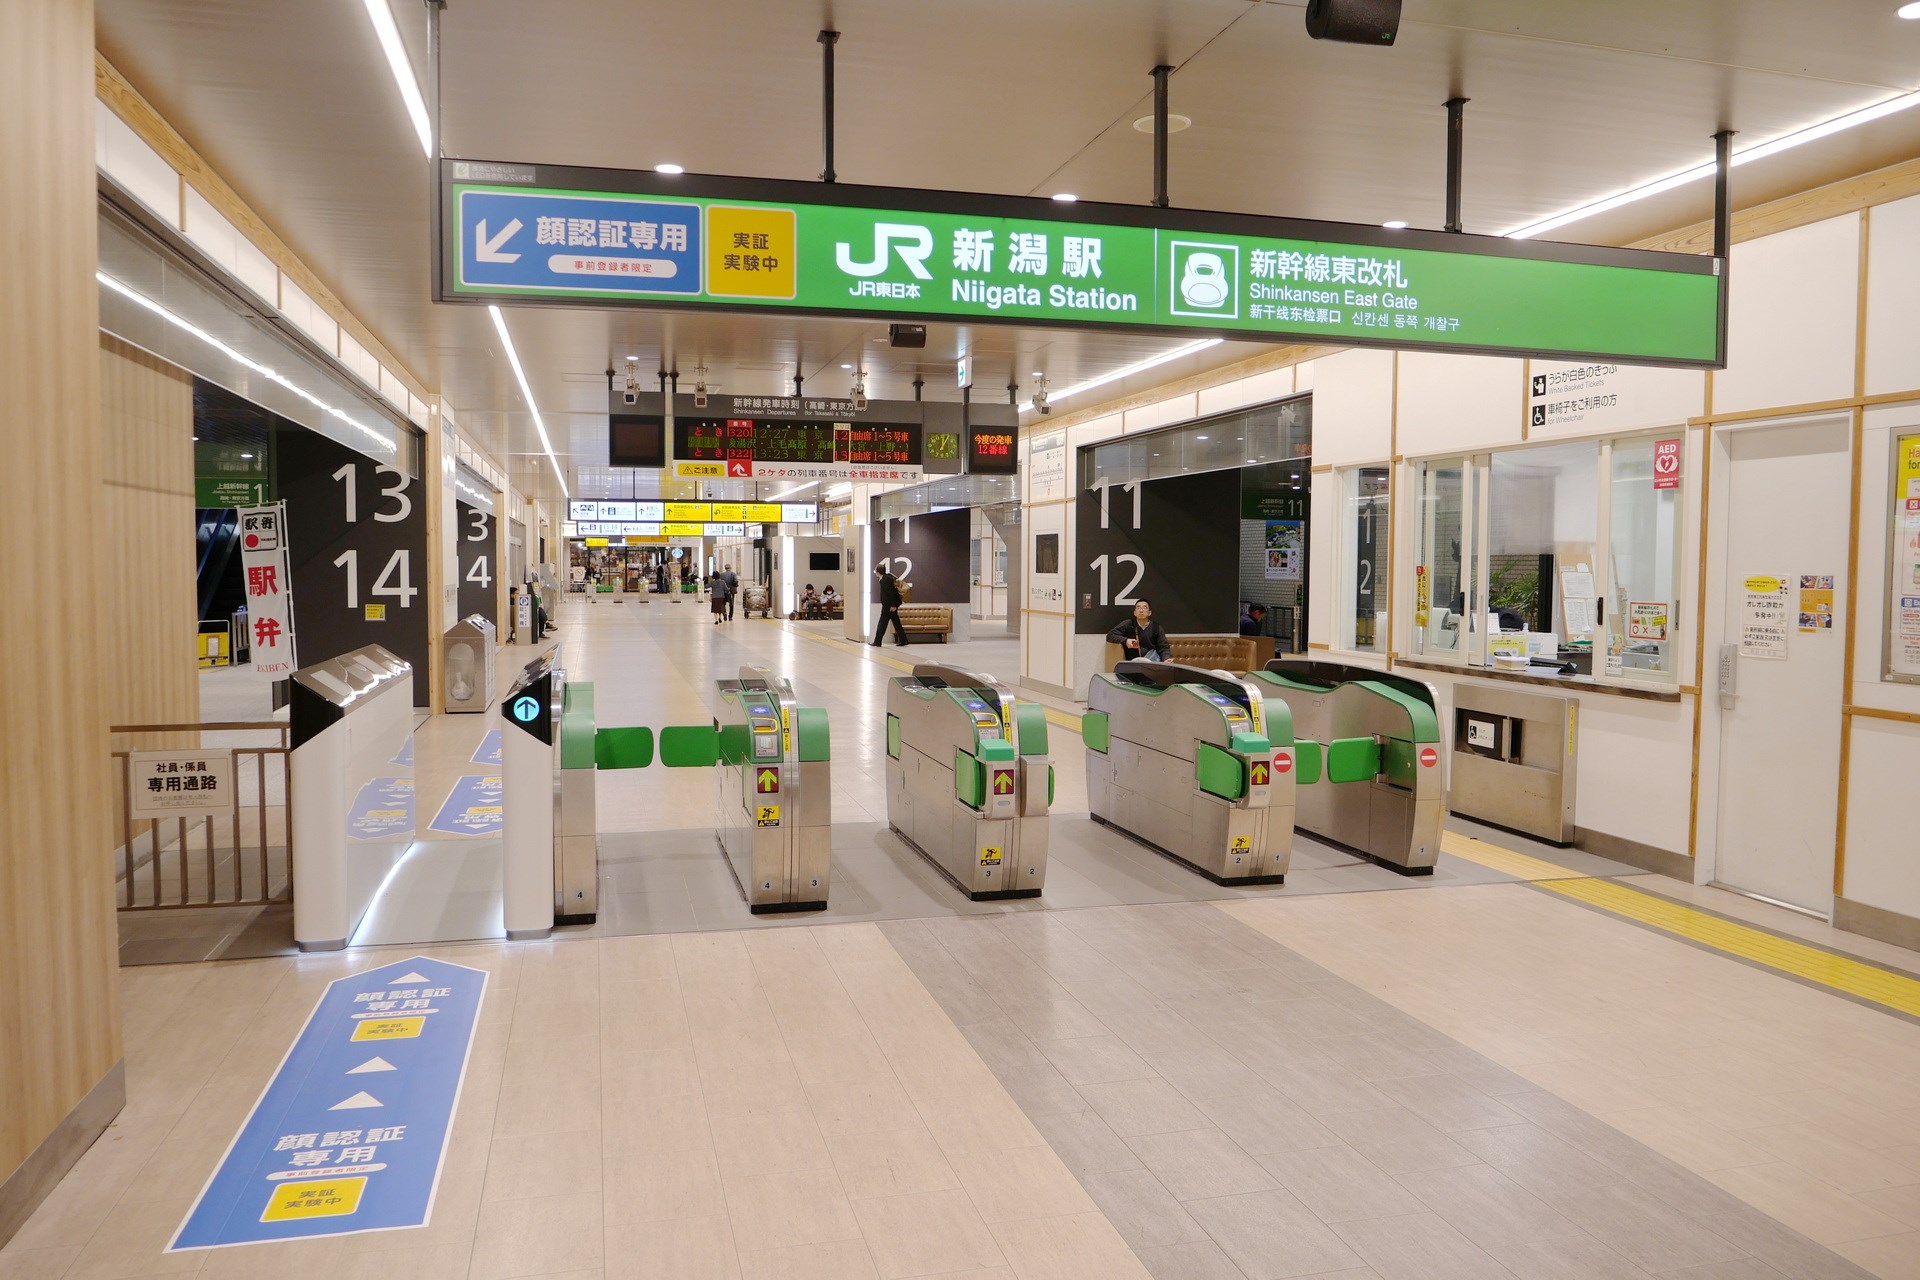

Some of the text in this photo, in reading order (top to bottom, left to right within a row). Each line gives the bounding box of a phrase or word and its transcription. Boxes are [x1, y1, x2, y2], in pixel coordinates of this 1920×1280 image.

[536, 216, 687, 252] 顔認証専用
[733, 232, 769, 250] 実証
[836, 222, 933, 280] JR
[952, 228, 1102, 279] 新潟駅
[574, 260, 653, 274] 事前登録者限定
[724, 253, 778, 272] 実験中
[1250, 249, 1408, 288] 新幹線東改札
[849, 281, 920, 299] JR東日本
[952, 279, 1137, 311] Niigata Station
[1250, 283, 1417, 310] Shinkansen East Gate
[1250, 303, 1341, 324] 新干线东检票口
[1352, 312, 1460, 332] 신칸센 동쪽 개찰구
[1549, 379, 1605, 395] White Backed Tickets
[734, 398, 800, 409] 新幹線発車時刻
[1548, 394, 1618, 415] 車椅子をご利用の方
[1556, 413, 1585, 424] Wheelchair
[694, 427, 723, 437] とき
[730, 429, 750, 438] 320
[754, 429, 789, 439] 12:27
[797, 430, 823, 440] 東京
[974, 434, 1012, 445] 今度の発車
[694, 448, 723, 458] とき
[730, 449, 750, 458] 322
[754, 449, 789, 459] 13:23
[797, 449, 823, 460] 東京
[979, 445, 1008, 455] 12番線
[1658, 444, 1677, 454] AED
[693, 466, 718, 474] ご注意
[332, 464, 412, 523] 13
[1091, 477, 1141, 529] 11
[1288, 499, 1303, 516] 11
[879, 514, 909, 544] 11
[333, 550, 417, 608] 14
[1090, 554, 1145, 605] 12
[247, 565, 281, 647] 駅弁
[257, 662, 289, 673] EKIBEN
[156, 761, 207, 773] 社員・係員
[147, 775, 217, 792] 専用通路
[577, 891, 583, 899] 4
[353, 987, 452, 1003] 顔認証
[365, 999, 431, 1011] 専用
[273, 1125, 407, 1151] 顔認証
[288, 1145, 377, 1167] 専用
[286, 1165, 369, 1177] 事前登録者限定
[299, 1188, 336, 1198] 実証
[284, 1197, 342, 1210] 実験中
